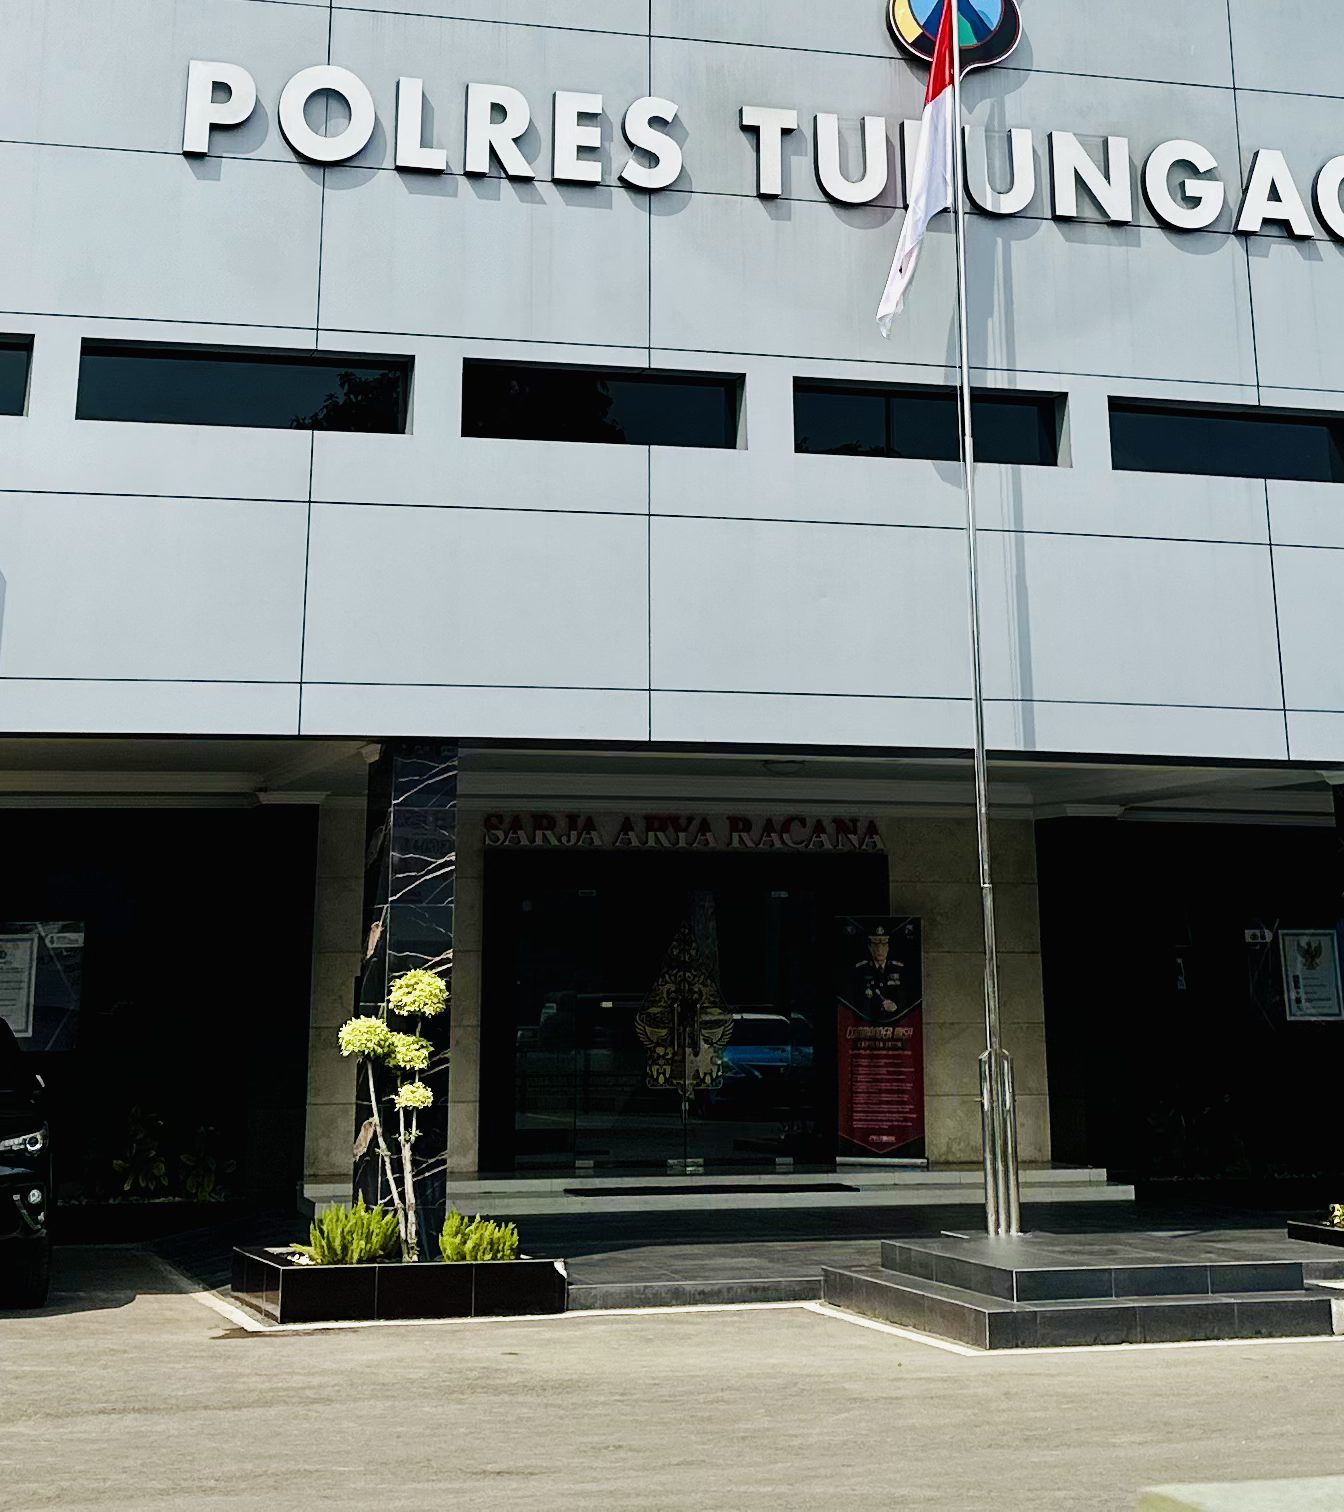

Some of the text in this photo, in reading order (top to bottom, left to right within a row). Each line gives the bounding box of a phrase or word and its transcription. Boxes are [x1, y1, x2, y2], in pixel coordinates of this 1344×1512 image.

[182, 59, 684, 189] POLRES
[483, 813, 887, 850] SARJA ARYA RACANA
